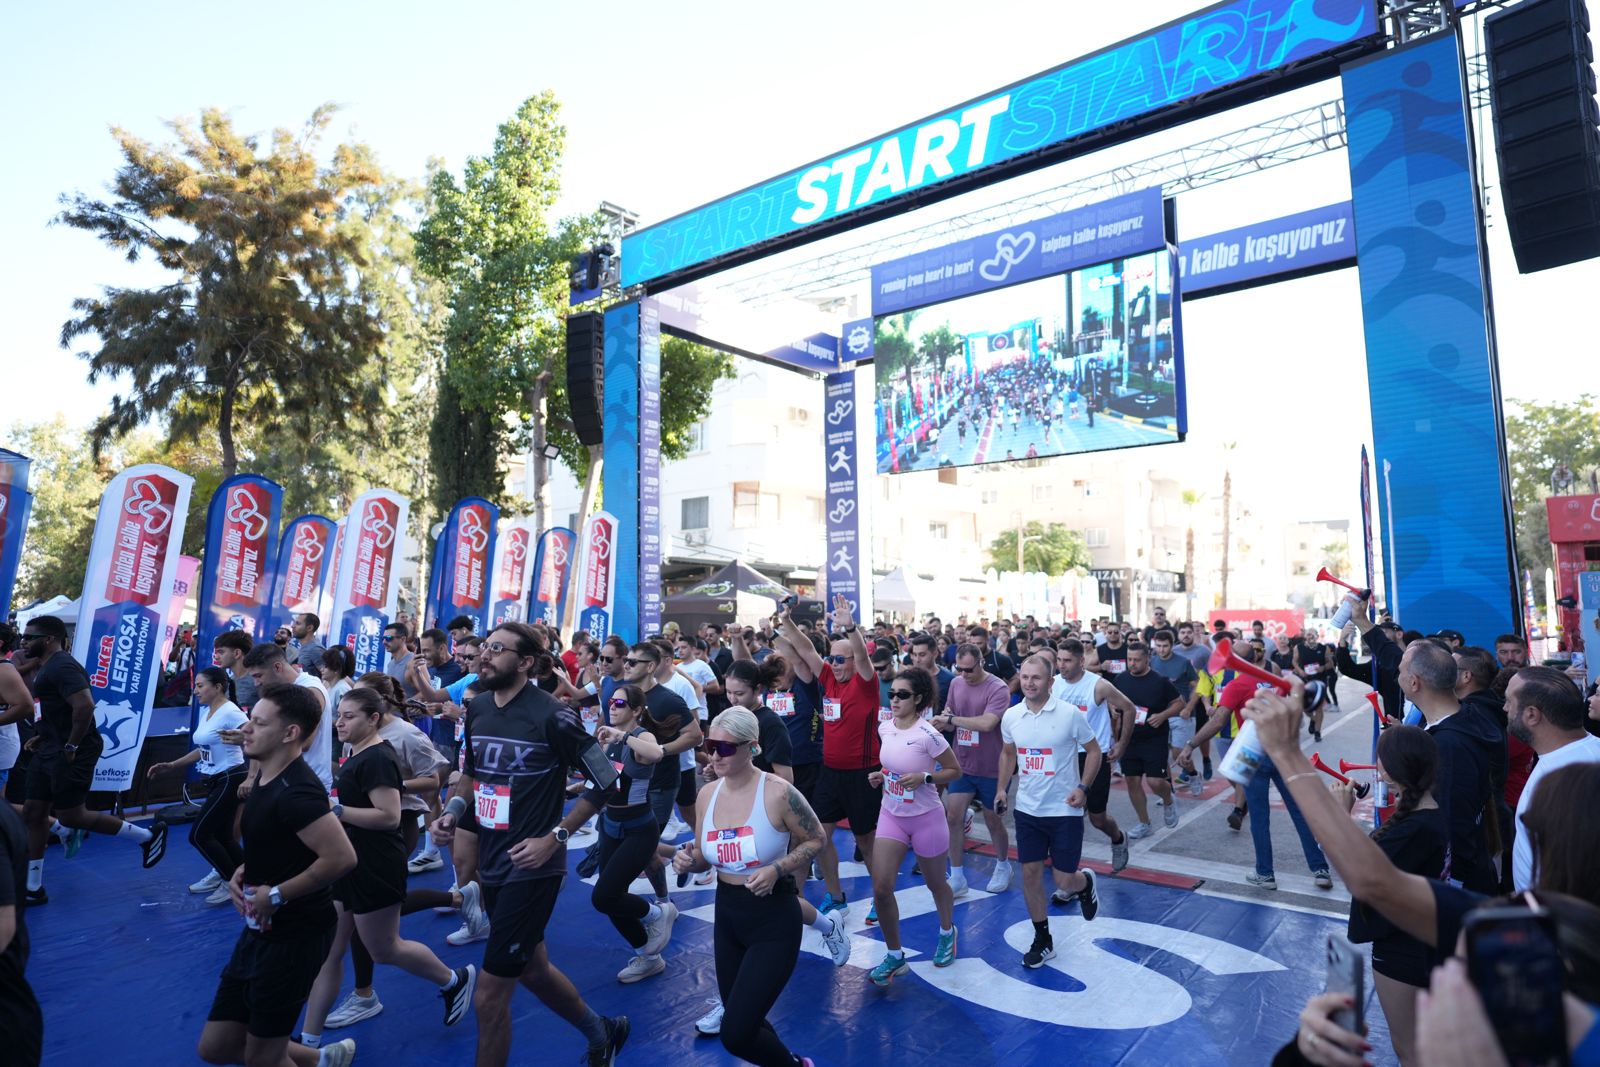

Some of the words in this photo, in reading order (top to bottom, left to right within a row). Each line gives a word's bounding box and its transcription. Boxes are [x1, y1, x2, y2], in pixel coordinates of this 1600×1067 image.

[639, 175, 799, 277] START
[791, 95, 1008, 224] START
[1003, 0, 1300, 151] START
[1190, 242, 1240, 275] kalbe
[1244, 218, 1347, 263] koşuyoruz
[880, 274, 907, 295] running
[907, 269, 924, 288] from
[925, 265, 944, 285] heart
[945, 265, 953, 281] to
[953, 258, 974, 279] heart
[118, 520, 141, 550] kalbe
[224, 528, 242, 556] kalbe
[359, 537, 374, 563] kalbe
[111, 550, 136, 590] kalpten
[132, 541, 158, 596] koşuyoruz
[220, 556, 239, 593] kalpten
[237, 547, 258, 598] koşuyoruz
[354, 562, 370, 595] kalpten
[110, 613, 138, 693] LEFKOŞA
[135, 616, 150, 670] MARATONU
[90, 635, 115, 689] ÜLKER
[130, 669, 141, 694] YARI
[95, 767, 131, 777] Lefkoşa
[1025, 757, 1045, 770] 5407
[717, 841, 742, 864] 5001
